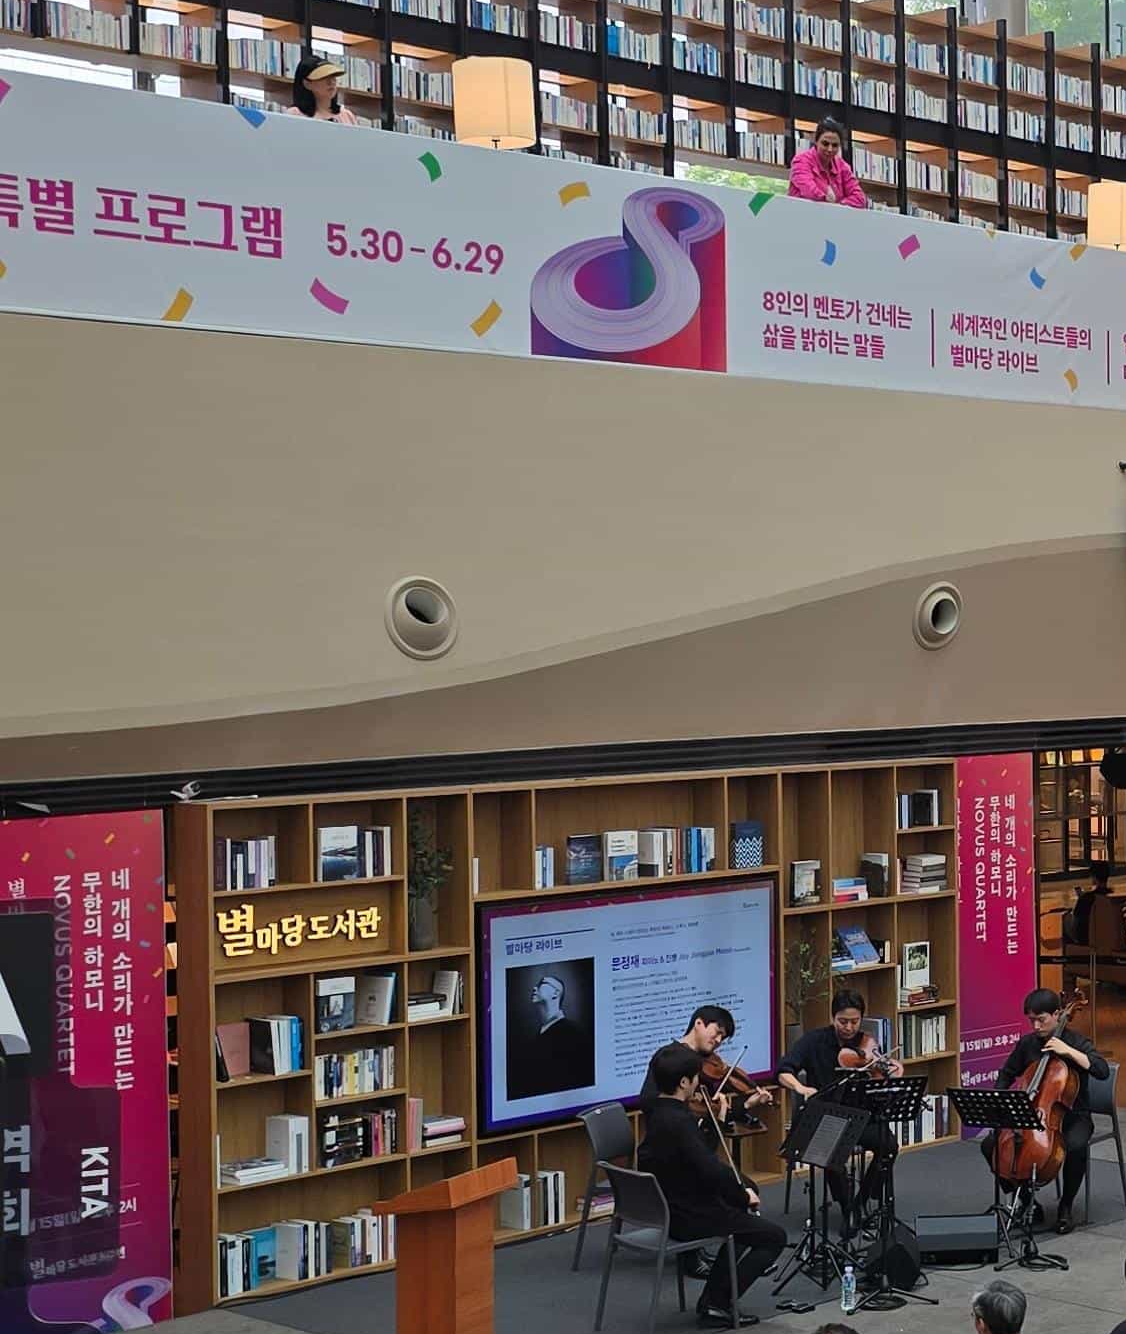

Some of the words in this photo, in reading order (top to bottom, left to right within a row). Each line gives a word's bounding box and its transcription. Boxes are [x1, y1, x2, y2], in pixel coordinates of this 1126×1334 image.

[94, 187, 283, 259] 프로그램
[762, 291, 808, 317] 8인의
[813, 296, 861, 323] 멘토가
[866, 302, 912, 329] 건네는
[950, 313, 1007, 340] 세계적인
[1011, 320, 1092, 350] 아티스트들의
[762, 323, 797, 350] 삶을
[800, 327, 850, 355] 밝히는
[853, 333, 886, 359] 말들
[950, 344, 993, 370] 별마당
[997, 350, 1039, 373] 라이브
[989, 796, 1000, 843] 무한의
[1004, 794, 1015, 810] 네
[974, 797, 985, 857] NOVUS
[1004, 816, 1016, 848] 개의
[111, 868, 130, 890] 네
[974, 861, 986, 942] QUARTET
[1004, 854, 1017, 901] 소리가
[53, 874, 72, 958] NOVUS
[82, 871, 102, 937] 무한의
[111, 898, 131, 942] 개의
[206, 903, 382, 958] 별마당도서관
[505, 940, 533, 956] 별마당
[535, 938, 563, 952] 라이브
[1006, 906, 1018, 955] 만드는
[83, 945, 105, 1012] 하모니
[112, 952, 133, 1016] 소리가
[55, 964, 75, 1076] QUARTET
[113, 1023, 135, 1091] 만드는
[81, 1146, 109, 1218] KITA
